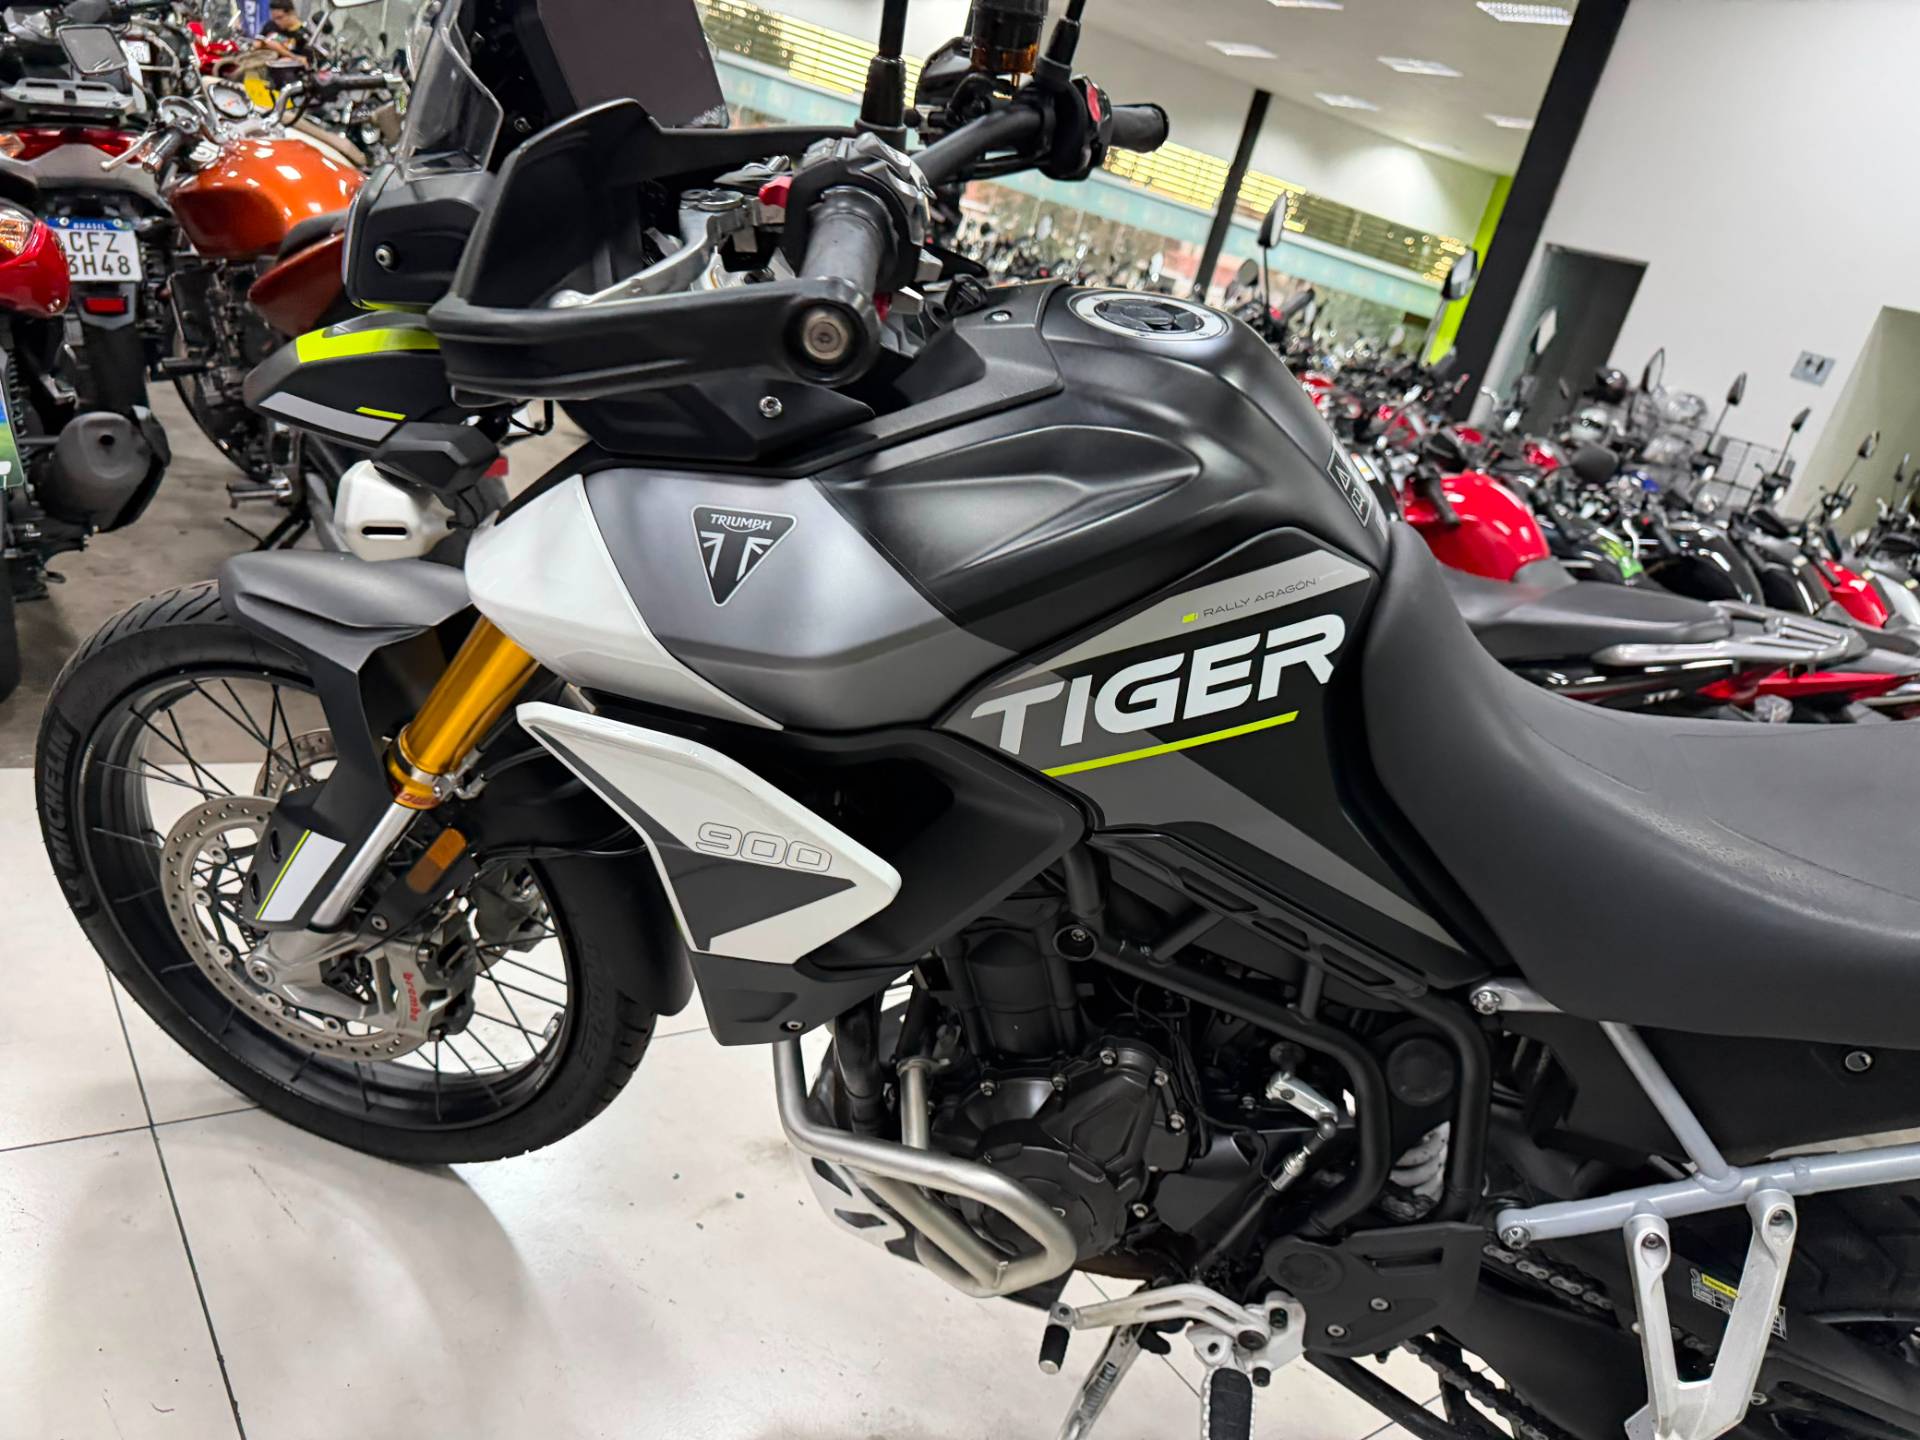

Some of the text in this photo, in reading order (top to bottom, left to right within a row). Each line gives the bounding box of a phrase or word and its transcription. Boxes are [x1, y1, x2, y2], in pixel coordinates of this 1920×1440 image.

[73, 222, 107, 230] BRASIL
[69, 231, 119, 253] CFZ
[67, 254, 131, 275] 3H48
[710, 513, 772, 532] TRIUMPH
[1203, 578, 1316, 617] RALLY ARAGÓN
[971, 614, 1346, 755] TIGER
[44, 711, 79, 871] MICHELIN
[696, 822, 832, 872] 900
